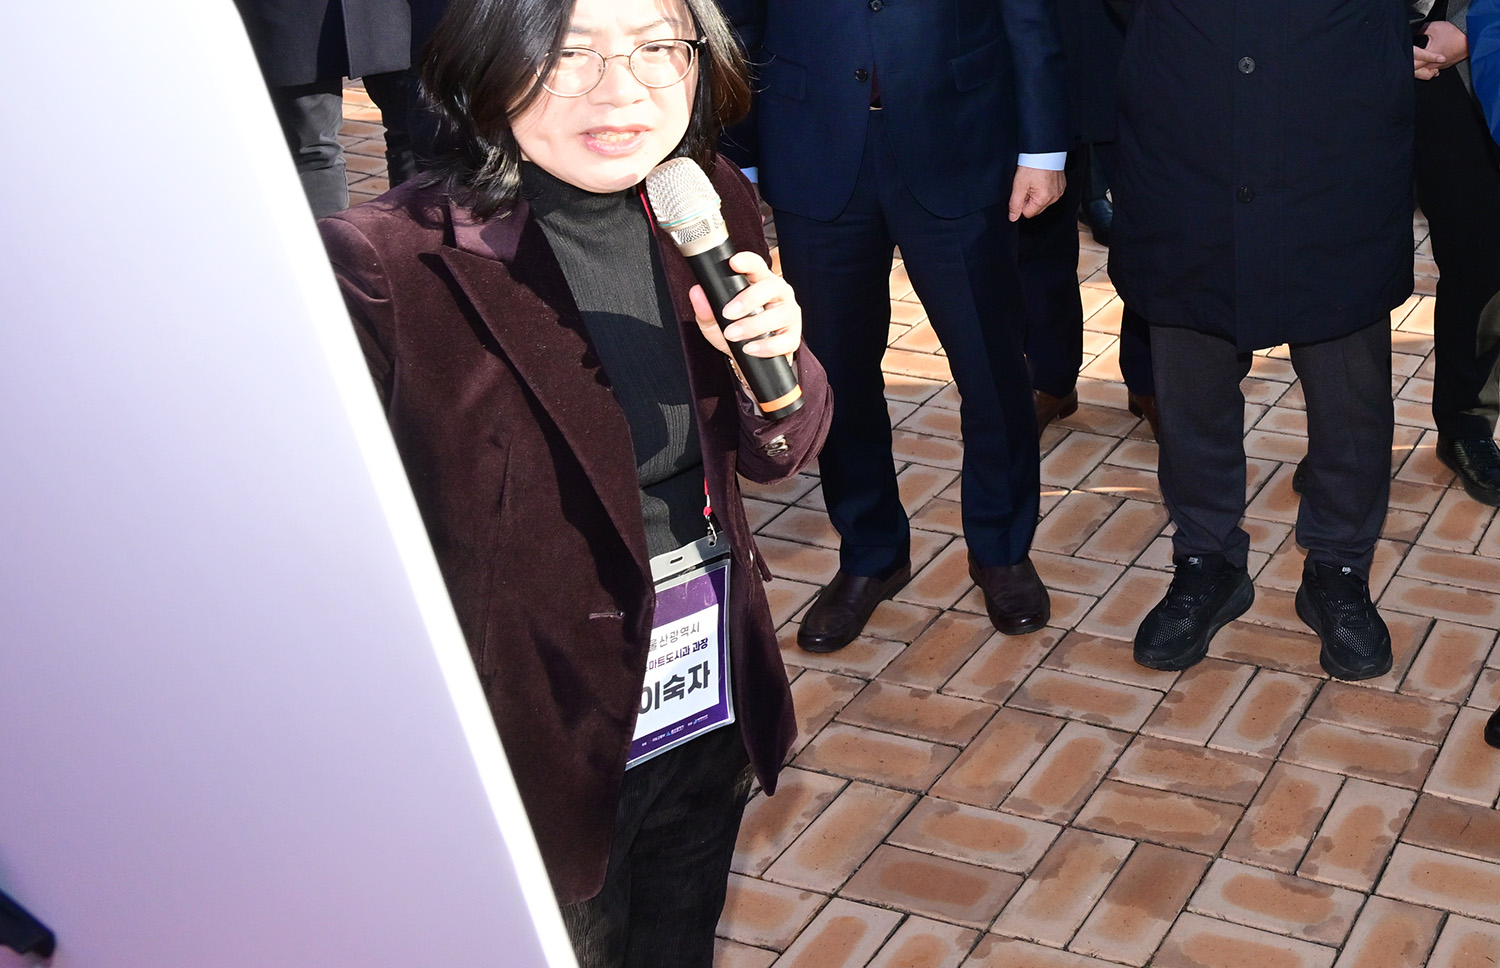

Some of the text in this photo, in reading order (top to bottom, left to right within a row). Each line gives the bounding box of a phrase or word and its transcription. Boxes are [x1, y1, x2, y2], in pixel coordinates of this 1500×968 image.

[645, 637, 709, 672] 마트도시과 과장
[638, 660, 711, 715] 이숙자
